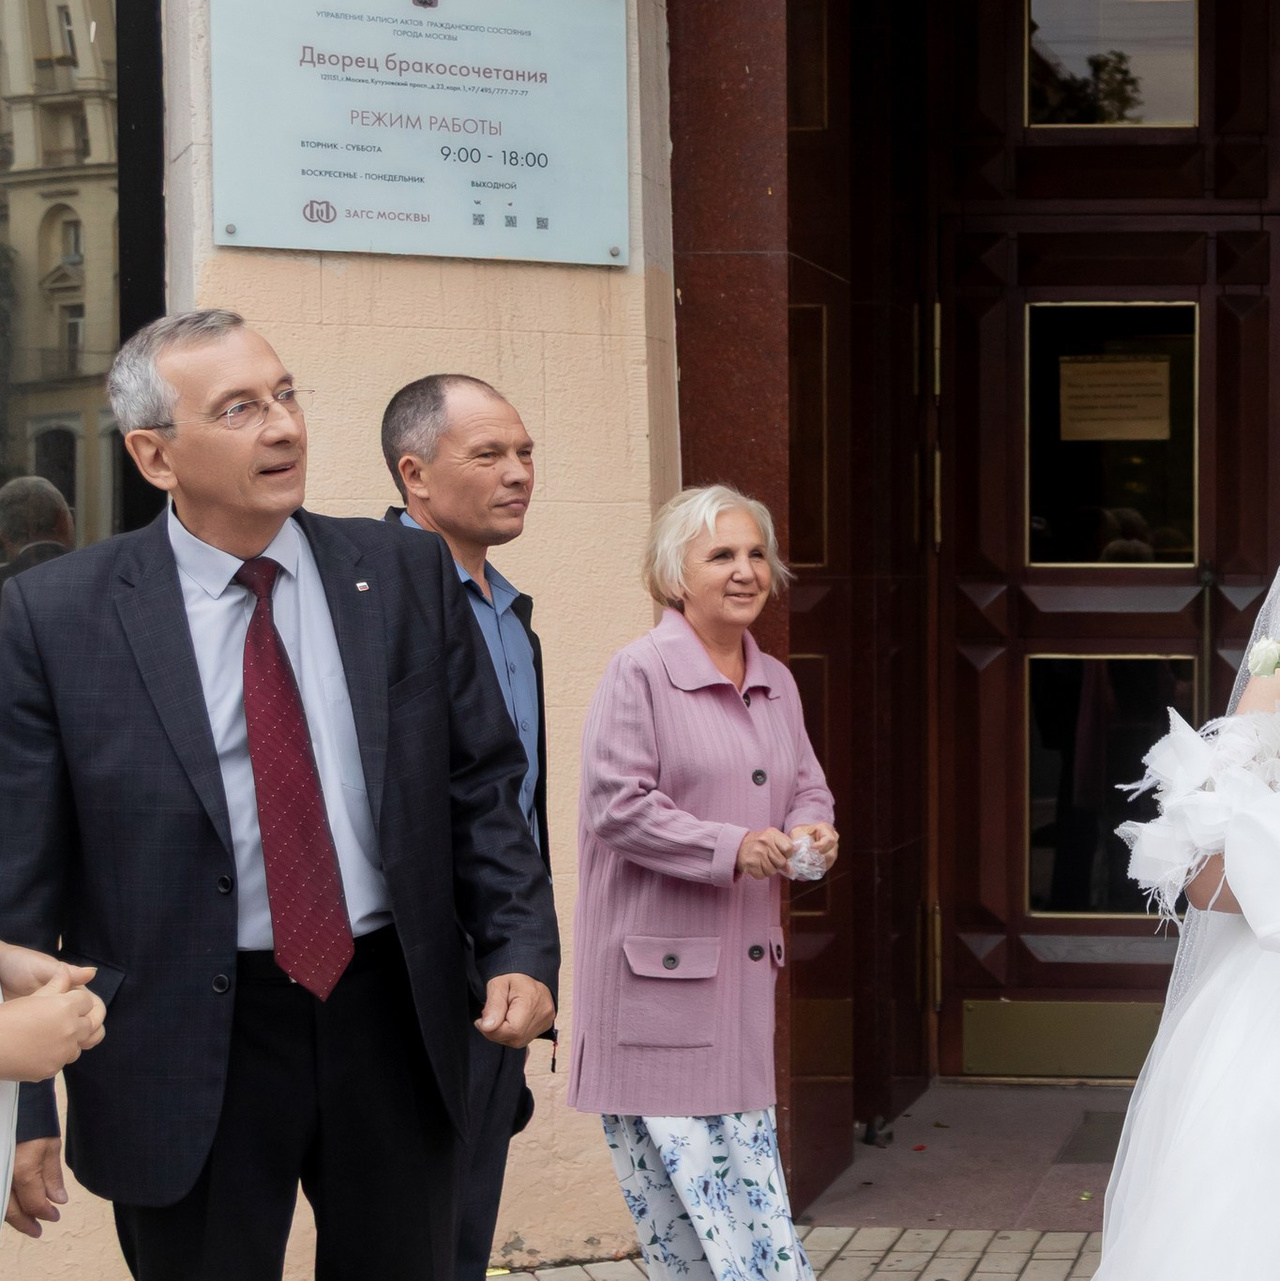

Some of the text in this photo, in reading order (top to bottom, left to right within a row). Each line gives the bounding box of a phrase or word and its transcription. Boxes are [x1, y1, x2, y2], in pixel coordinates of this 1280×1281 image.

[316, 10, 532, 37] УПРАВЛЕНИЕ ЗАПИСИ АКТОВ ГРАЖДАНСКОГО СОСТОЯНИЯ
[393, 29, 458, 41] ГОРОДА МОСКВЫ
[299, 45, 548, 84] Дворец бракосочетания
[350, 109, 502, 136] РЕЖИМ РАБОТЫ
[300, 140, 339, 150] ВТОРНИК
[345, 143, 383, 153] СУББОТА
[440, 146, 481, 164] 9:00
[501, 150, 548, 168] 18:00
[301, 169, 358, 180] ВОСКРЕСЕНЬЕ
[364, 173, 425, 183] ПОНЕДЕЛЬНИК
[471, 179, 517, 190] ВЫХОДНОЙ
[345, 208, 430, 222] ЗАГС МОСКВЫ
